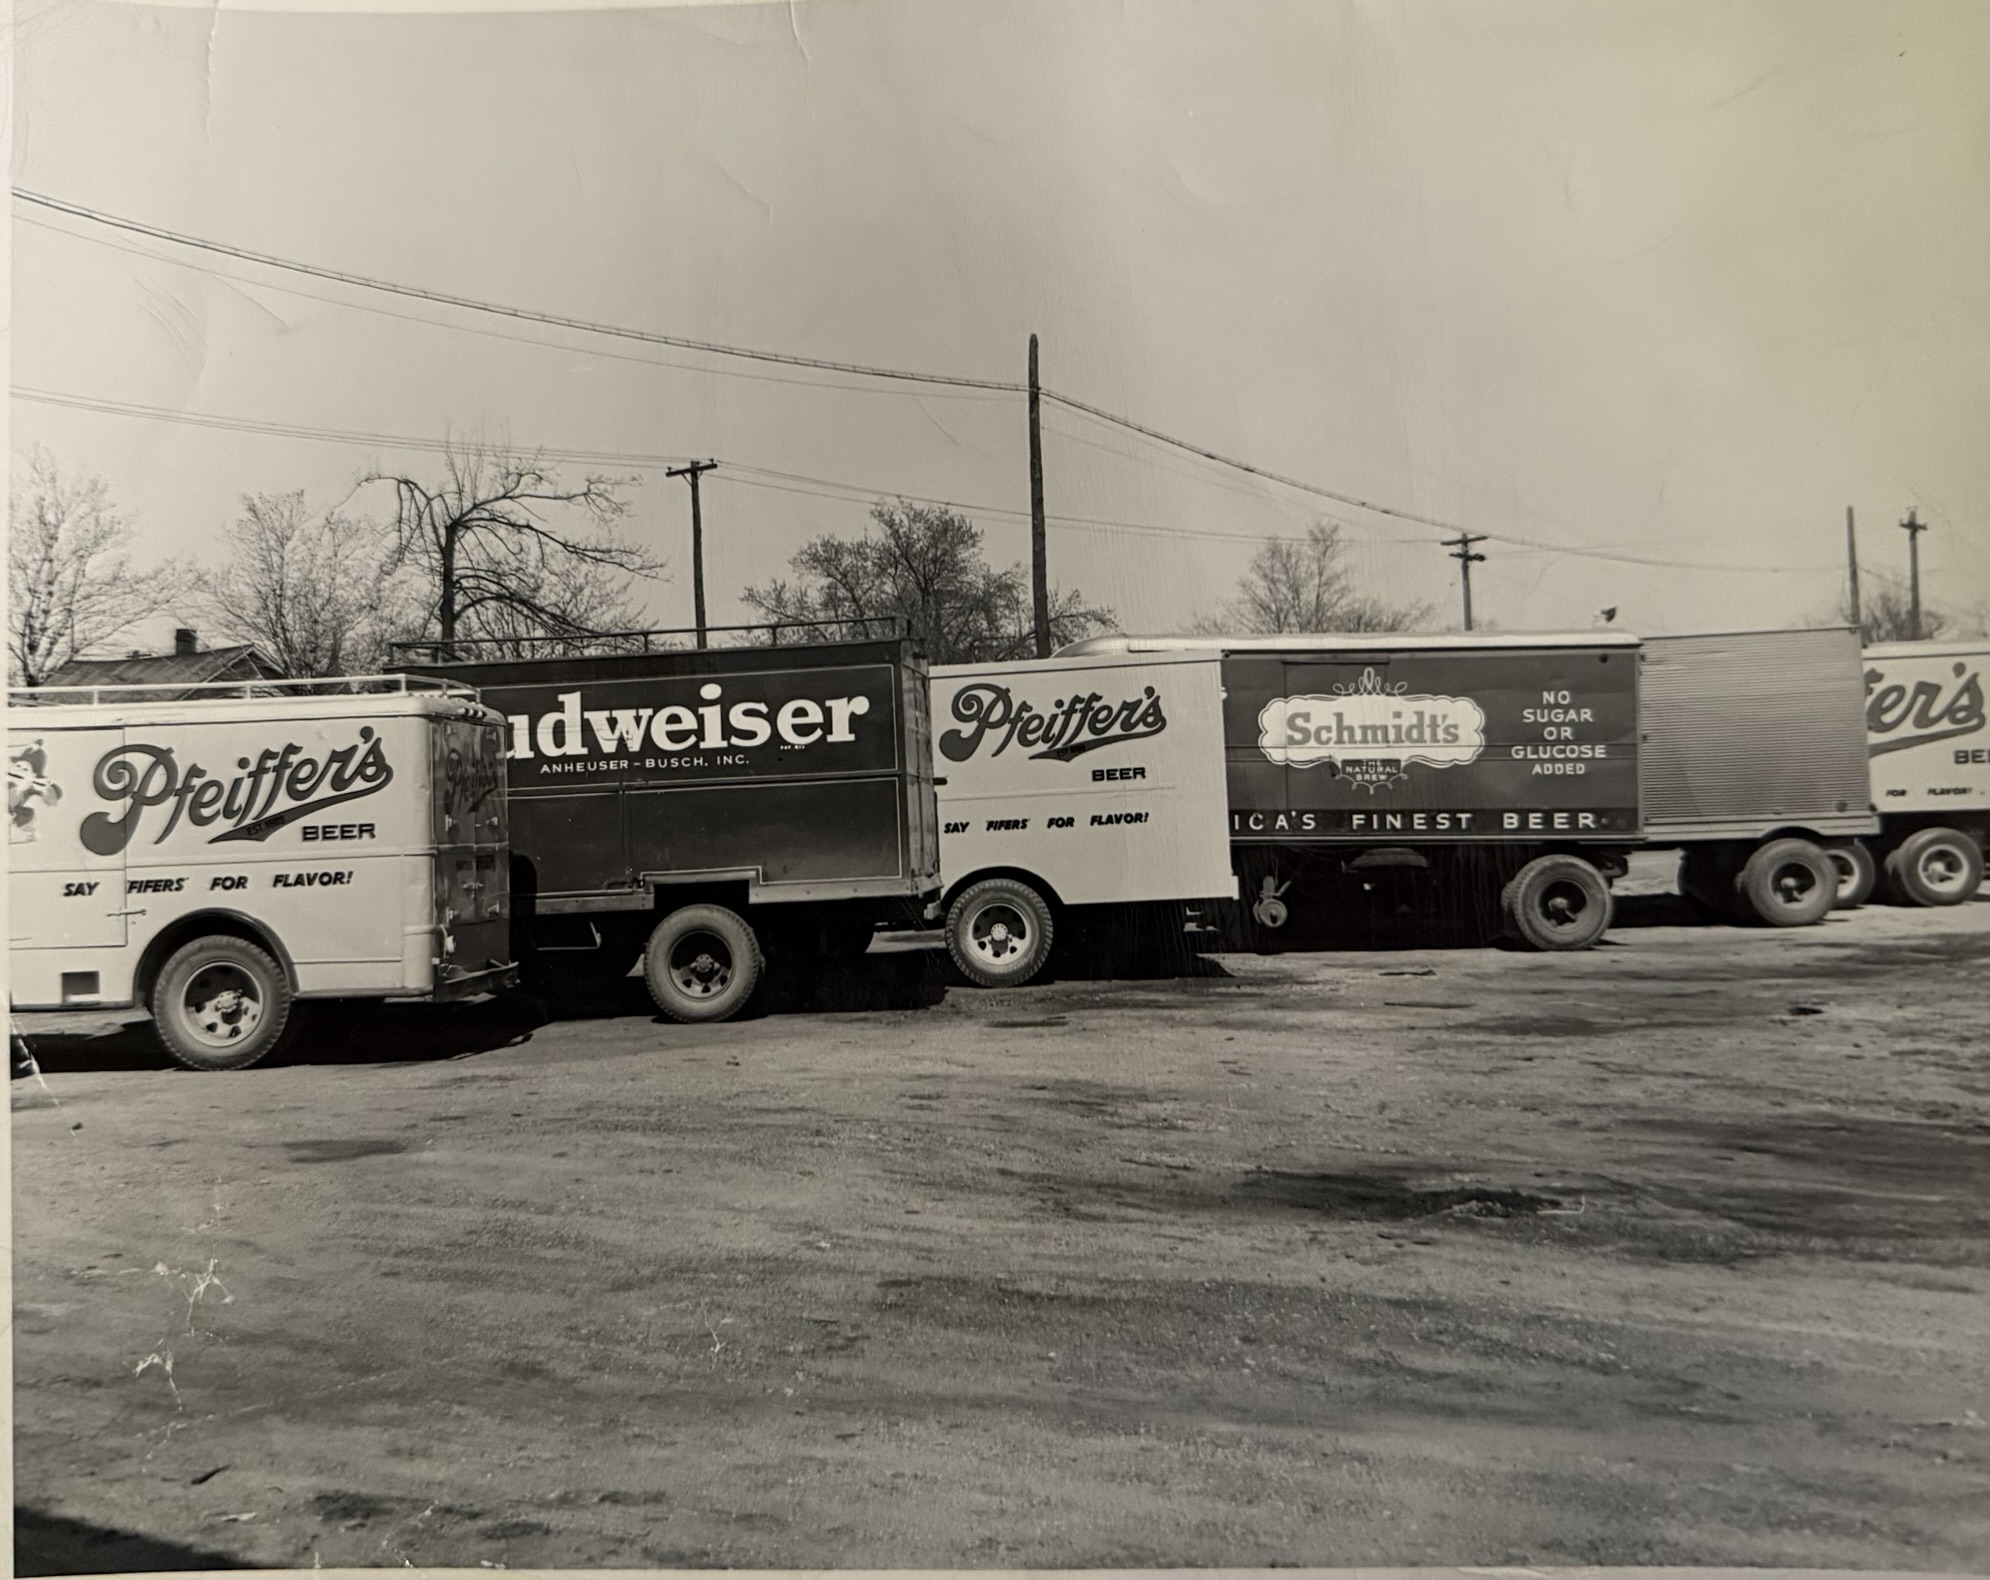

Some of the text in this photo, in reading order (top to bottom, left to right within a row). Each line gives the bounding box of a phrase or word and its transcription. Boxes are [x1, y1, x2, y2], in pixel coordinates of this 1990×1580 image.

[1542, 690, 1571, 705] NO
[939, 683, 1167, 762] Pfeiffer's
[1522, 708, 1593, 723] SUGAR
[1286, 711, 1460, 746] Schmidt's
[1543, 726, 1574, 740] OR
[1510, 744, 1607, 759] GLUCOSE
[1953, 748, 1990, 765] BE
[717, 754, 750, 766] INC.
[1091, 766, 1147, 782] BEER
[1345, 765, 1398, 774] NATURAL
[1531, 762, 1586, 775] ADDED
[1355, 773, 1388, 781] BREW
[80, 726, 394, 856] Pfeiffer's
[943, 821, 970, 834] SAY
[1046, 816, 1076, 829] FOR
[1089, 811, 1150, 827] FLAVOR!
[1351, 812, 1473, 830] FINEST
[301, 823, 377, 842] BEER
[63, 881, 101, 897] SAY
[209, 875, 249, 891] FOR
[272, 870, 354, 888] FLAVOR!
